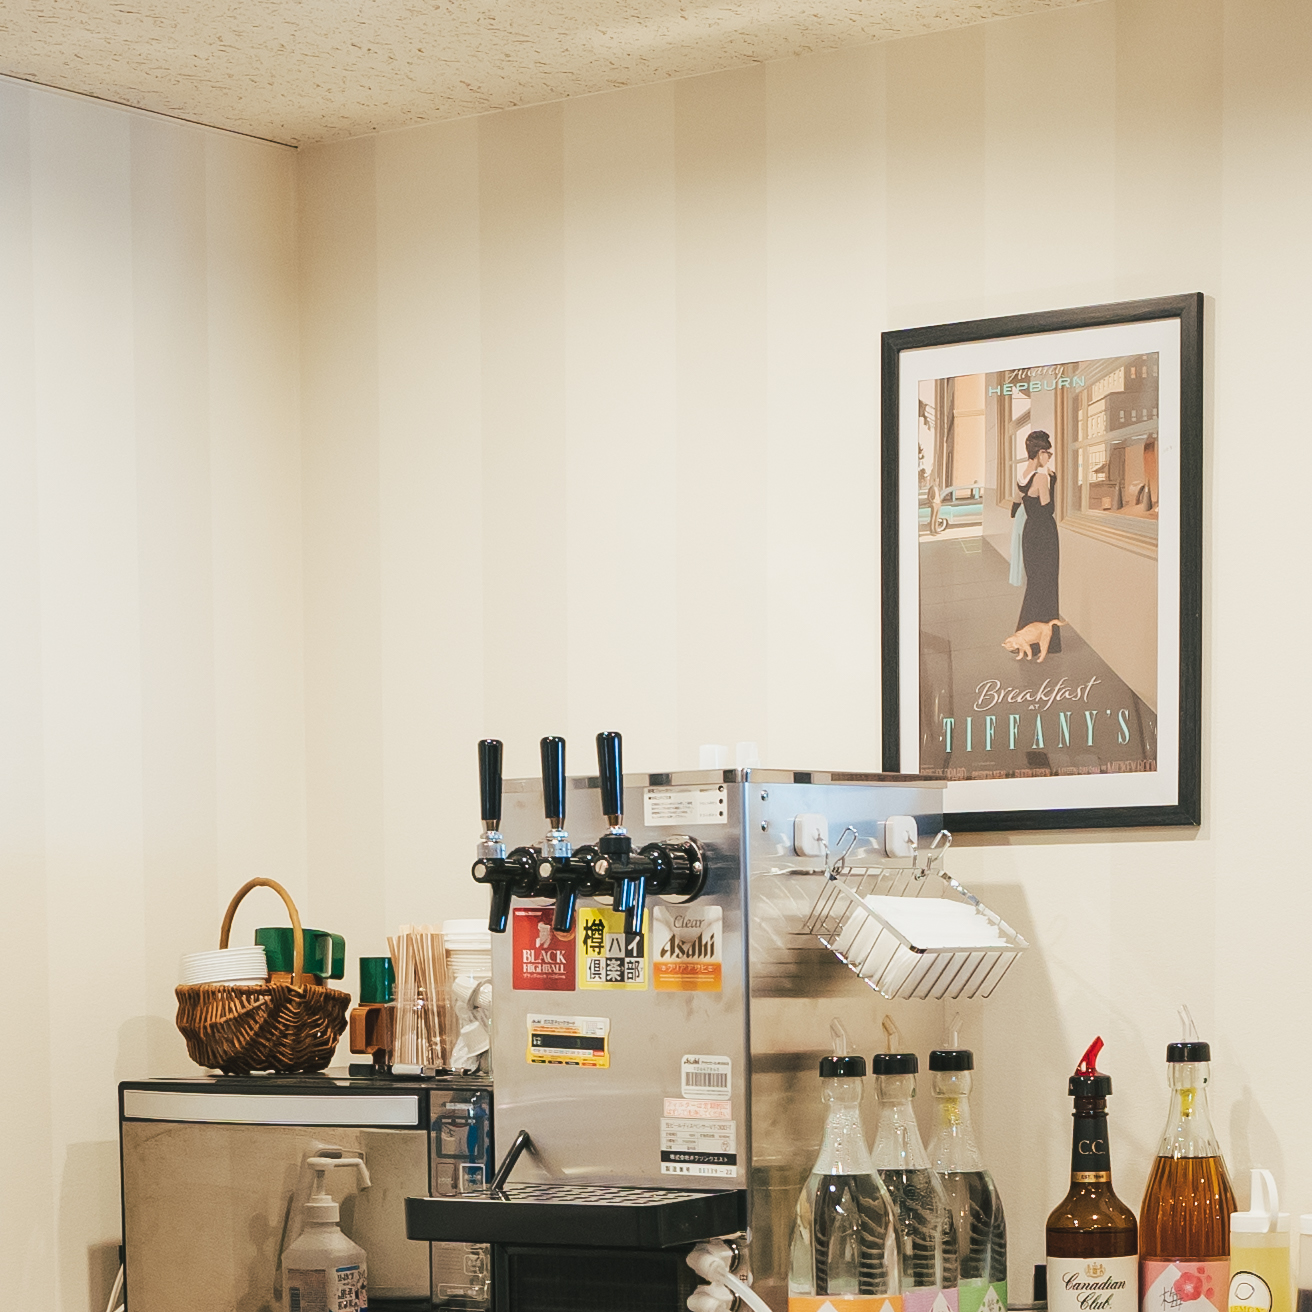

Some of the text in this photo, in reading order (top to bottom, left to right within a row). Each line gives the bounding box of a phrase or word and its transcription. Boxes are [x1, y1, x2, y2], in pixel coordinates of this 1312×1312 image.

[988, 376, 1086, 397] HEPBURN
[973, 675, 1101, 712] Breakfast
[942, 708, 1131, 753] TIFFANY'S
[673, 914, 705, 929] Clear
[659, 932, 715, 959] Asahi
[523, 950, 567, 964] BLACK
[523, 964, 567, 973] HIGHBALL
[588, 959, 642, 981] 倶楽部
[1063, 1266, 1126, 1292] Canadian
